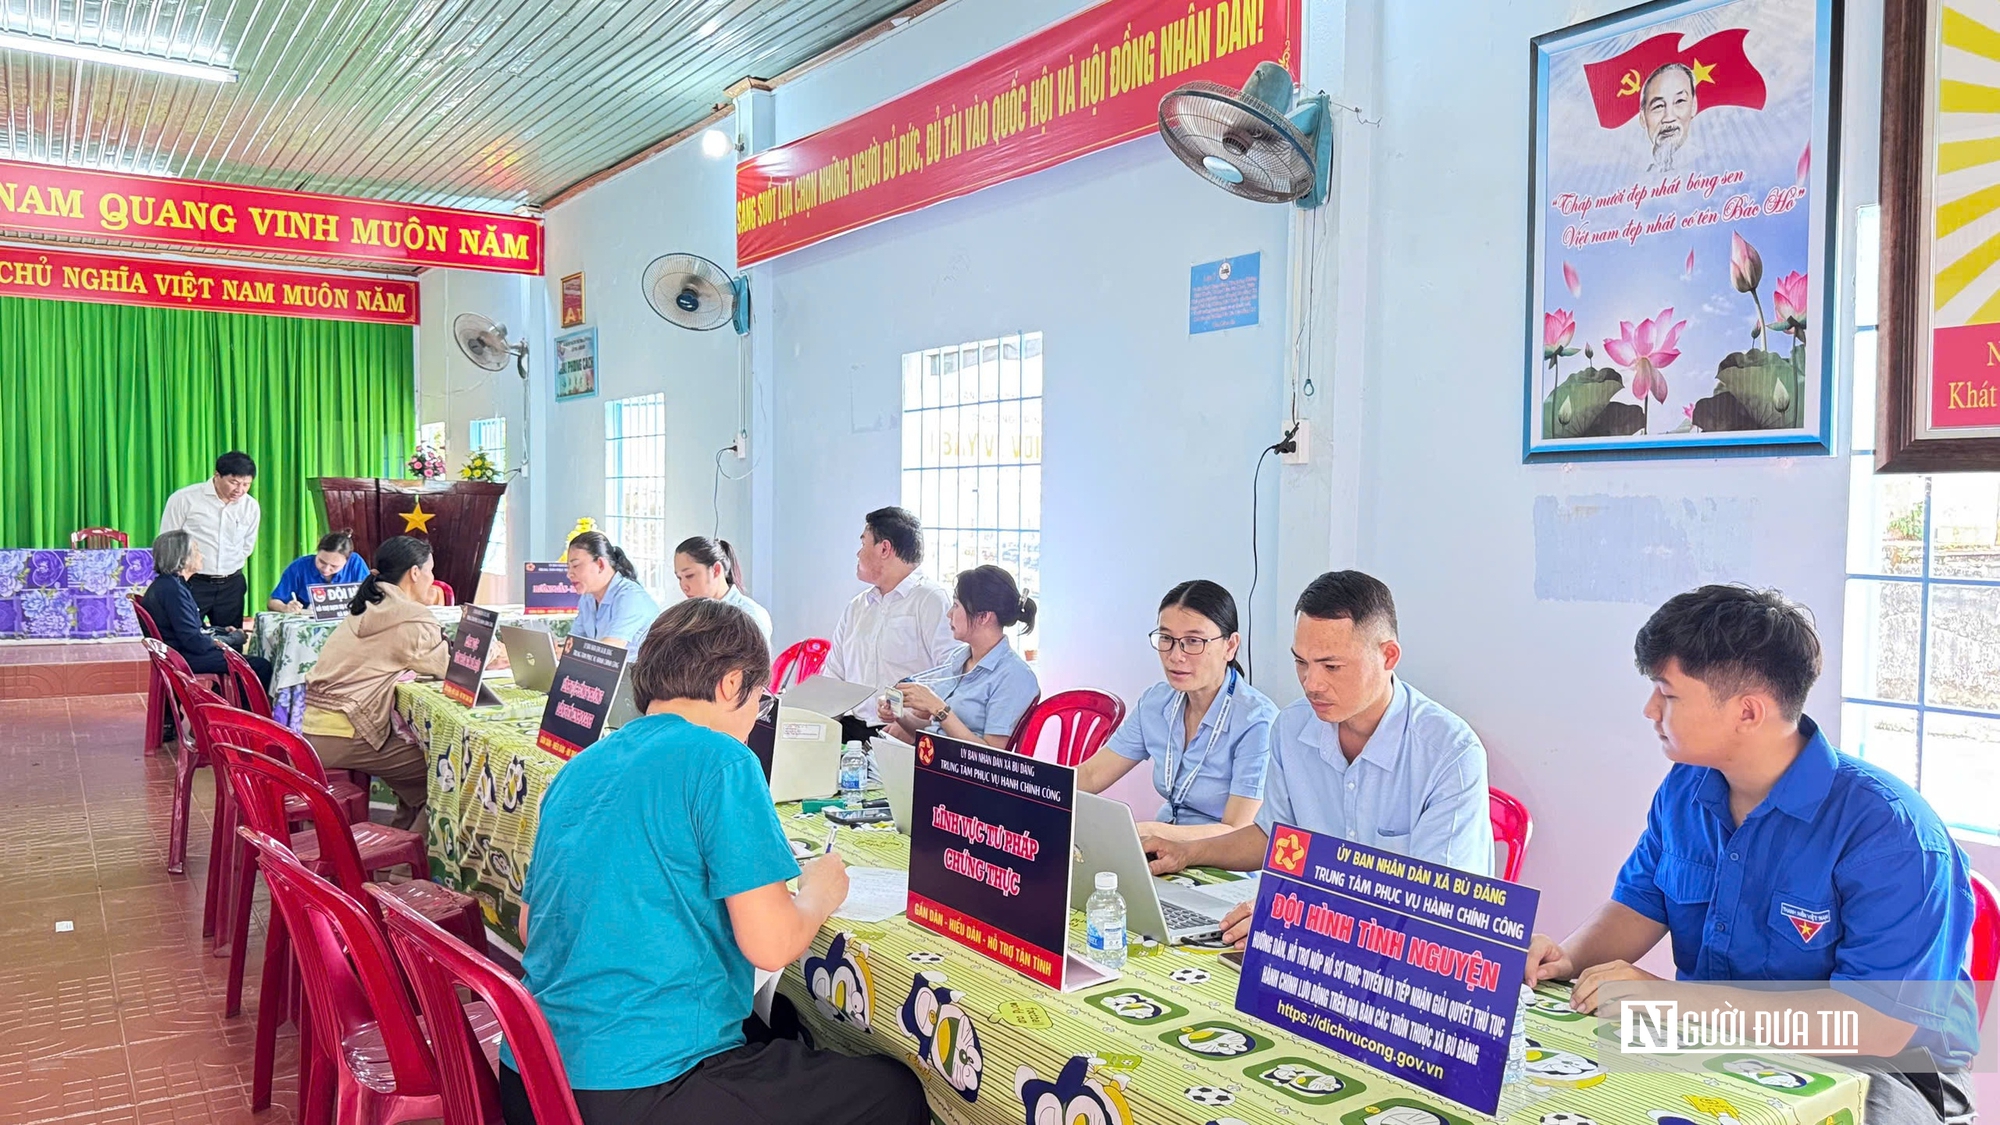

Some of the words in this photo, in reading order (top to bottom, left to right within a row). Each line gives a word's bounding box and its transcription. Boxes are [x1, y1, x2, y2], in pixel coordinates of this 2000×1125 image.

[737, 192, 756, 235] SÁNG
[758, 175, 777, 227] SUỐT
[778, 178, 793, 226] LỰA
[794, 168, 817, 218] CHỌN
[819, 155, 849, 205] NHỮNG
[851, 136, 880, 193] NGƯỜI
[883, 124, 897, 181] ĐỦ
[899, 122, 923, 175] ĐỨC,
[925, 105, 941, 166] ĐỦ
[944, 104, 962, 159] TÀI
[965, 94, 988, 151] VÀO
[992, 70, 1027, 146] QUỐC
[1030, 65, 1053, 135] HỘI
[1057, 54, 1076, 117] VÀ
[1080, 43, 1106, 116] HỘI
[1110, 22, 1155, 98] ĐỒNG
[1159, 2, 1211, 79] NHÂN
[1563, 221, 1589, 249] Việt
[1591, 228, 1619, 245] nam
[1622, 219, 1643, 246] đẹp
[1646, 211, 1676, 235] nhất
[1722, 193, 1760, 223] Bác
[1627, 183, 1648, 210] đẹp
[1650, 176, 1681, 199] nhất
[1686, 173, 1719, 197] bông
[1720, 169, 1745, 185] sen
[0, 183, 84, 219] NAM
[99, 192, 237, 233] QUANG
[249, 206, 339, 242] VINH
[351, 215, 448, 252] MUÔN
[458, 224, 529, 260] NĂM
[0, 256, 52, 287] CHỦ
[62, 265, 148, 294] NGHĨA
[153, 270, 214, 302] VIỆT
[222, 279, 275, 304] NAM
[282, 282, 349, 309] MUÔN
[356, 287, 405, 313] NĂM
[1948, 380, 1998, 409] Khát
[940, 759, 960, 773] TRUNG
[960, 763, 973, 777] TÂM
[973, 768, 990, 783] PHỤC
[990, 772, 1000, 787] VỤ
[1000, 774, 1019, 790] HÀNH
[1020, 781, 1041, 797] CHÍNH
[1041, 785, 1061, 802] CÔNG
[968, 749, 978, 761] BAN
[978, 751, 992, 765] NHÂN
[992, 754, 1003, 769] DÂN
[932, 804, 960, 835] LĨNH
[960, 816, 985, 844] VỰC
[985, 824, 1004, 849] TƯ
[1003, 830, 1039, 861] PHÁP
[944, 848, 985, 882] CHỨNG
[985, 862, 1020, 897] THỰC
[1314, 865, 1346, 887] TRUNG
[1348, 874, 1372, 895] TÂM
[1374, 882, 1402, 904] PHỤC
[1405, 891, 1421, 912] VỤ
[1422, 896, 1454, 920] HÀNH
[1456, 907, 1490, 930] CHÍNH
[1492, 916, 1524, 940] CÔNG
[1336, 843, 1352, 862] ỦY
[1352, 851, 1375, 870] BAN
[1376, 857, 1406, 878] NHÂN
[1407, 865, 1432, 885] DÂN
[1433, 873, 1449, 891] XÃ
[1453, 877, 1471, 896] BÙ
[1473, 883, 1507, 906] ĐĂNG
[929, 909, 944, 927] DÂN
[966, 925, 982, 944] DÂN
[999, 940, 1014, 961] TRỢ
[1015, 947, 1031, 967] TẬN
[1032, 954, 1052, 977] TÌNH
[1271, 892, 1304, 929] ĐỘI
[1305, 902, 1354, 943] HÌNH
[1357, 917, 1406, 962] TÌNH
[1407, 936, 1501, 992] NGUYỆN
[1261, 963, 1280, 988] HÀNH
[1278, 971, 1299, 996] CHÍNH
[1297, 979, 1312, 1001] LƯU
[1310, 982, 1330, 1008] ĐỘNG
[1328, 990, 1348, 1013] TRÊN
[1358, 1001, 1375, 1025] BÀN
[1373, 1006, 1390, 1031] CÁC
[1389, 1013, 1410, 1039] THÔN
[1408, 1018, 1434, 1050] THUỘC
[1432, 1029, 1446, 1054] XÃ
[1444, 1032, 1458, 1057] BÙ
[1456, 1037, 1480, 1066] ĐĂNG
[1296, 946, 1311, 971] TRỢ
[1308, 948, 1325, 975] NỘP
[1333, 959, 1345, 980] SƠ
[1343, 962, 1362, 989] TRỰC
[1361, 968, 1385, 994] TUYẾN
[1383, 974, 1395, 999] VÀ
[1393, 977, 1411, 1003] TIẾP
[1409, 986, 1432, 1014] NHẬN
[1431, 990, 1449, 1018] GIẢI
[1447, 999, 1474, 1026] QUYẾT
[1472, 1005, 1490, 1032] THỦ
[1488, 1013, 1506, 1040] TỤC
[1276, 999, 1444, 1080] https://dichvucong.gov.vn
